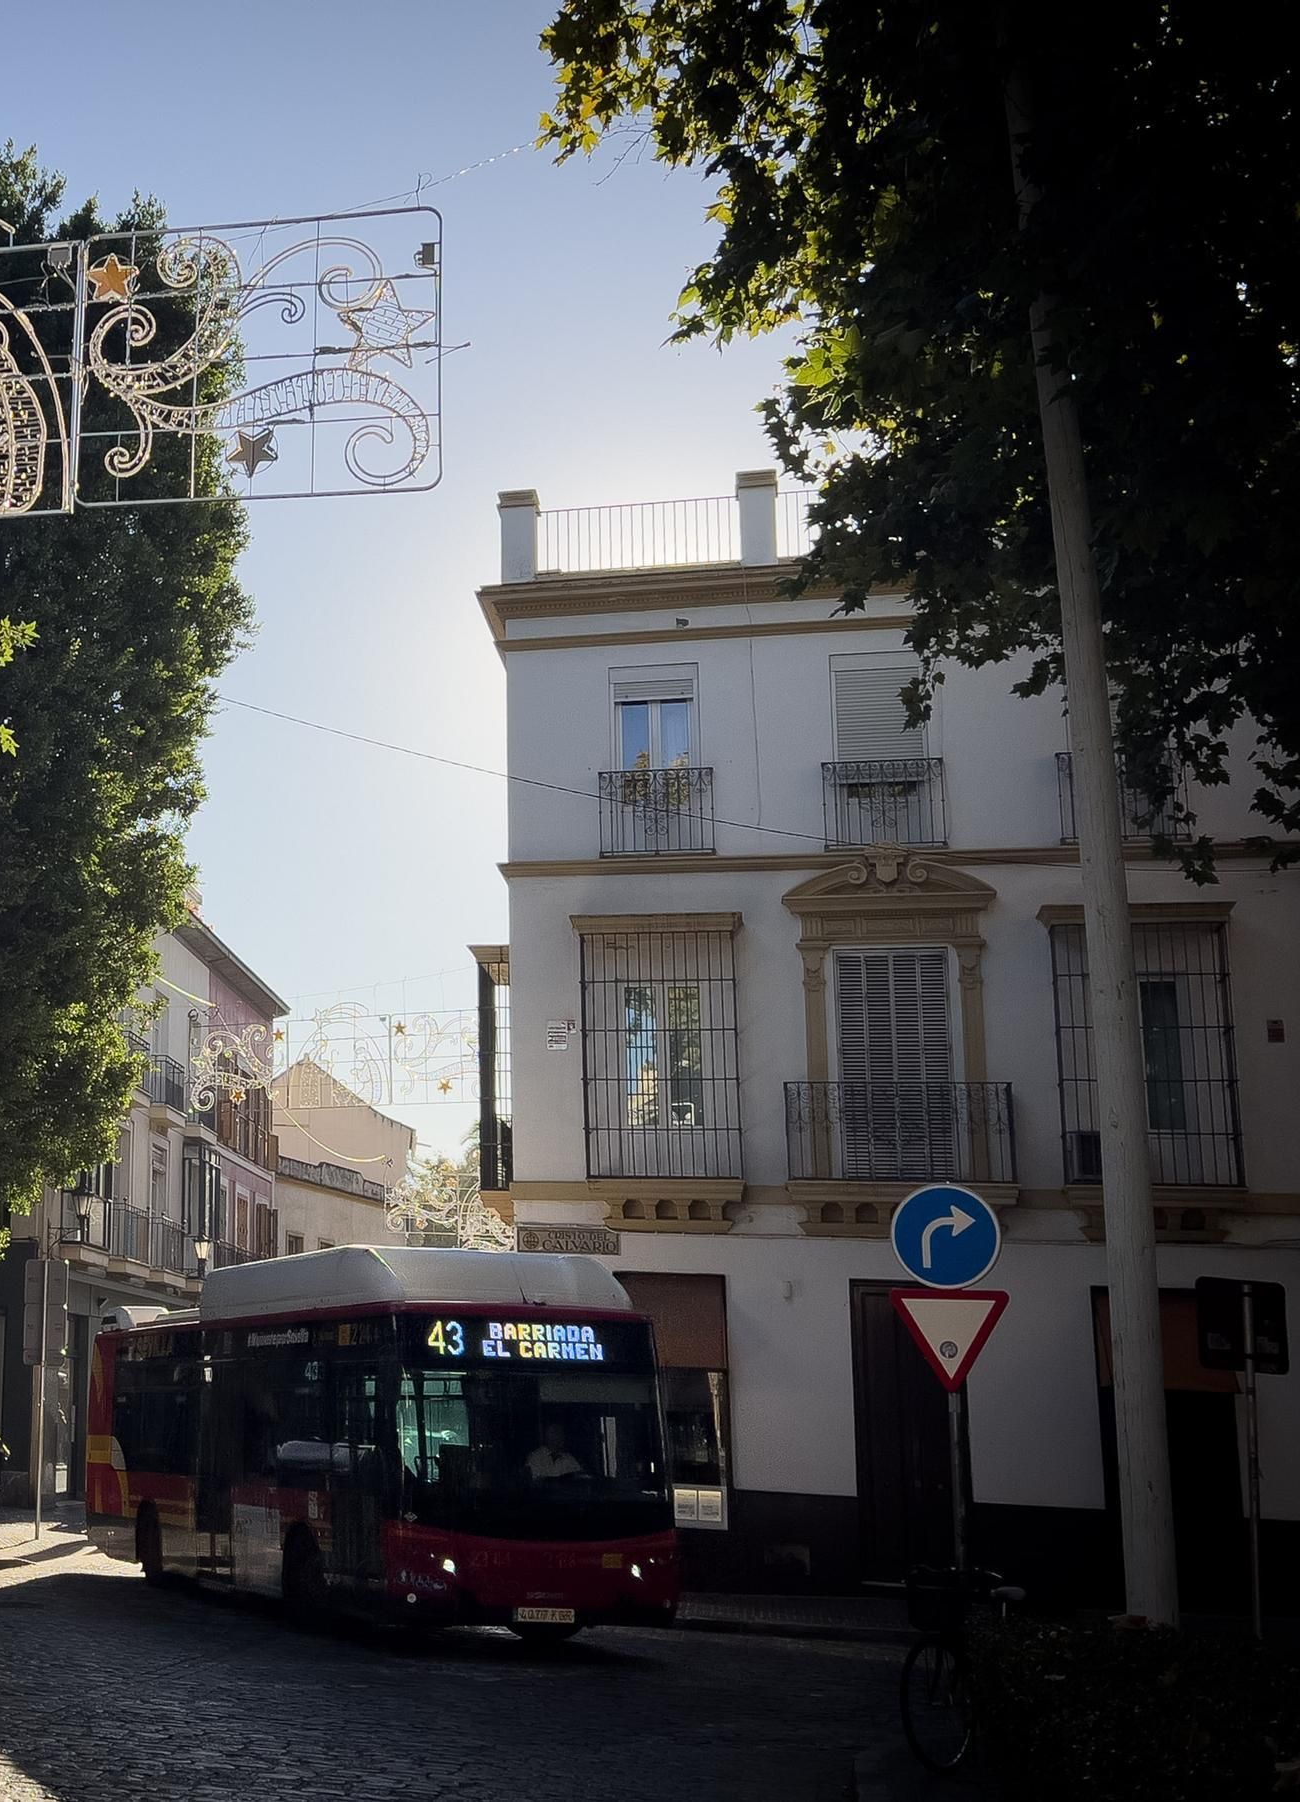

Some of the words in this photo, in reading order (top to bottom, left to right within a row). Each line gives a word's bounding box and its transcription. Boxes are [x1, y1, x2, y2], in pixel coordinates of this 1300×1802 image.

[548, 1230, 585, 1240] CRISTO
[589, 1231, 610, 1241] DEL
[542, 1240, 617, 1254] CALVARIO
[428, 1320, 465, 1356] 43
[489, 1322, 596, 1343] BARRIADA
[482, 1340, 512, 1358] EL
[518, 1341, 604, 1361] CARMEN
